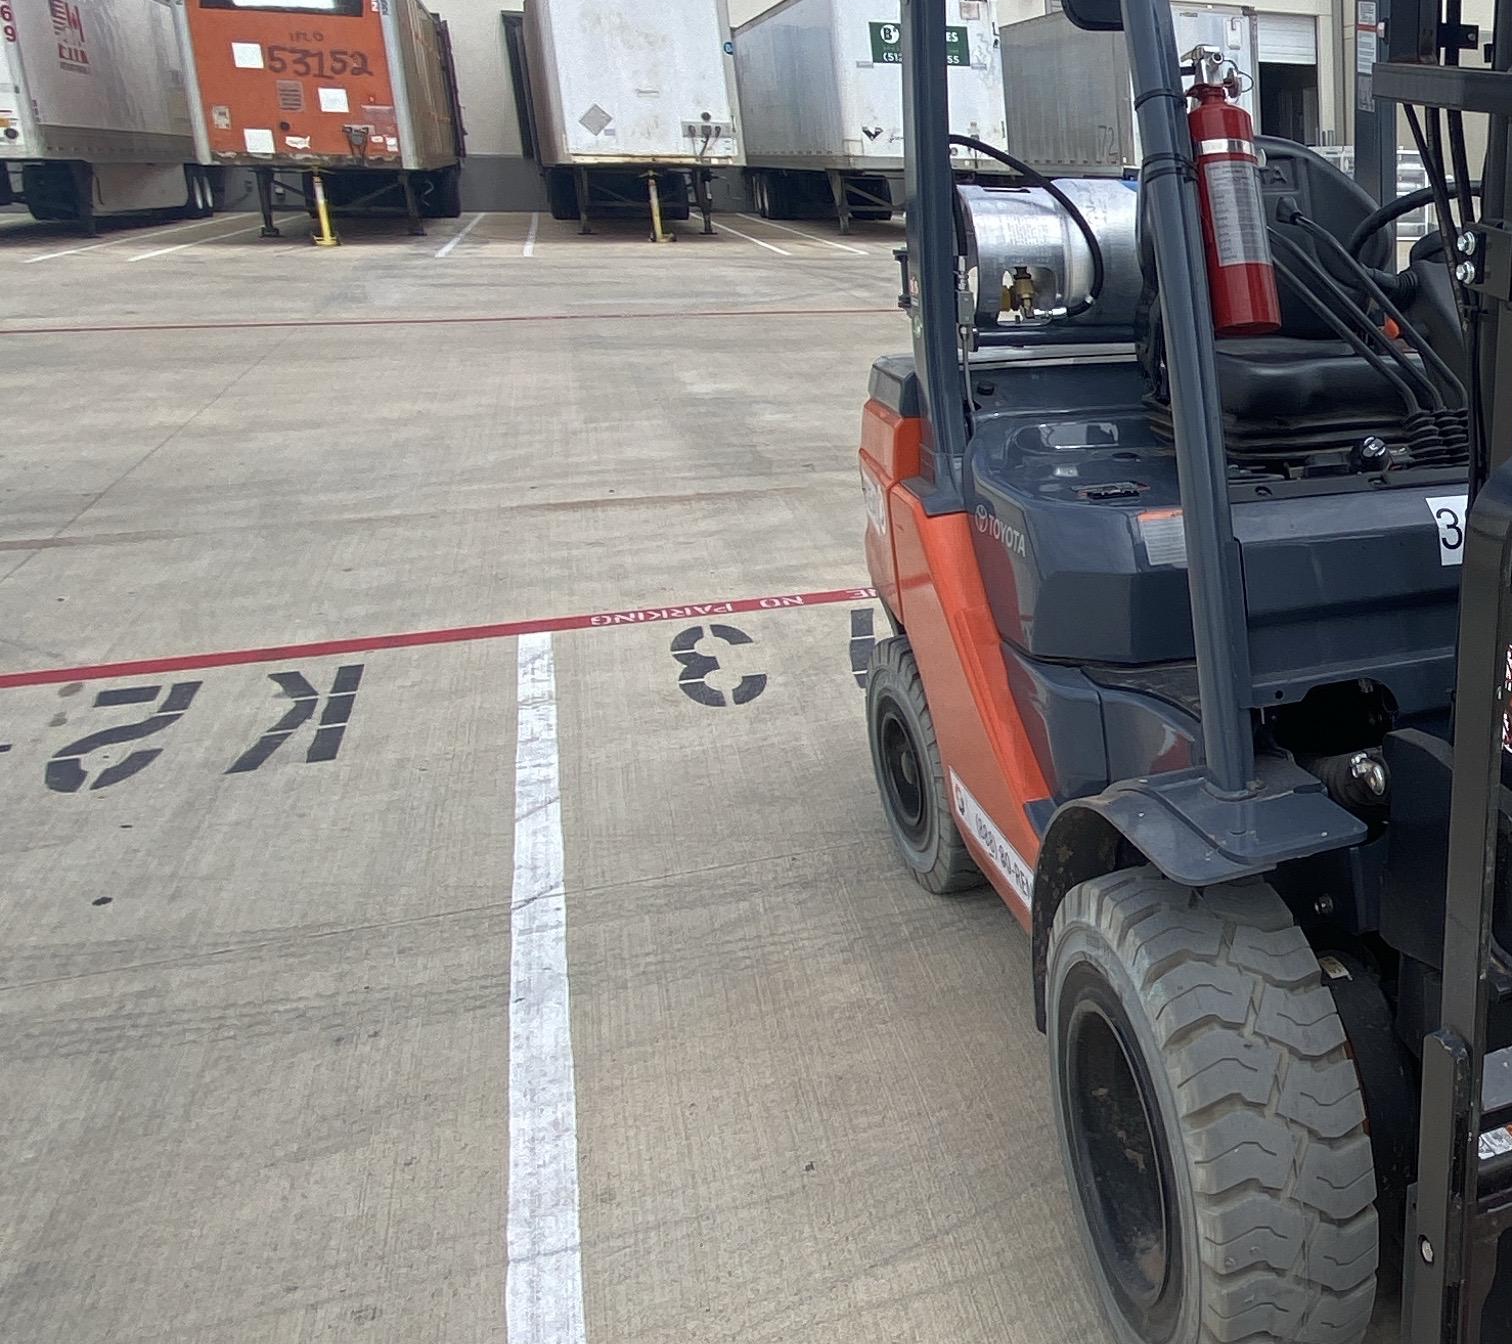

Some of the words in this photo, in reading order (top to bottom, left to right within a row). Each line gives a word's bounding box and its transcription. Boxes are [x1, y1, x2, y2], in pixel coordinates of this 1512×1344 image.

[267, 45, 374, 80] 53152
[988, 512, 1027, 558] TOYOTA
[1435, 507, 1463, 551] 3
[590, 602, 734, 626] PARKING
[759, 595, 804, 608] NO
